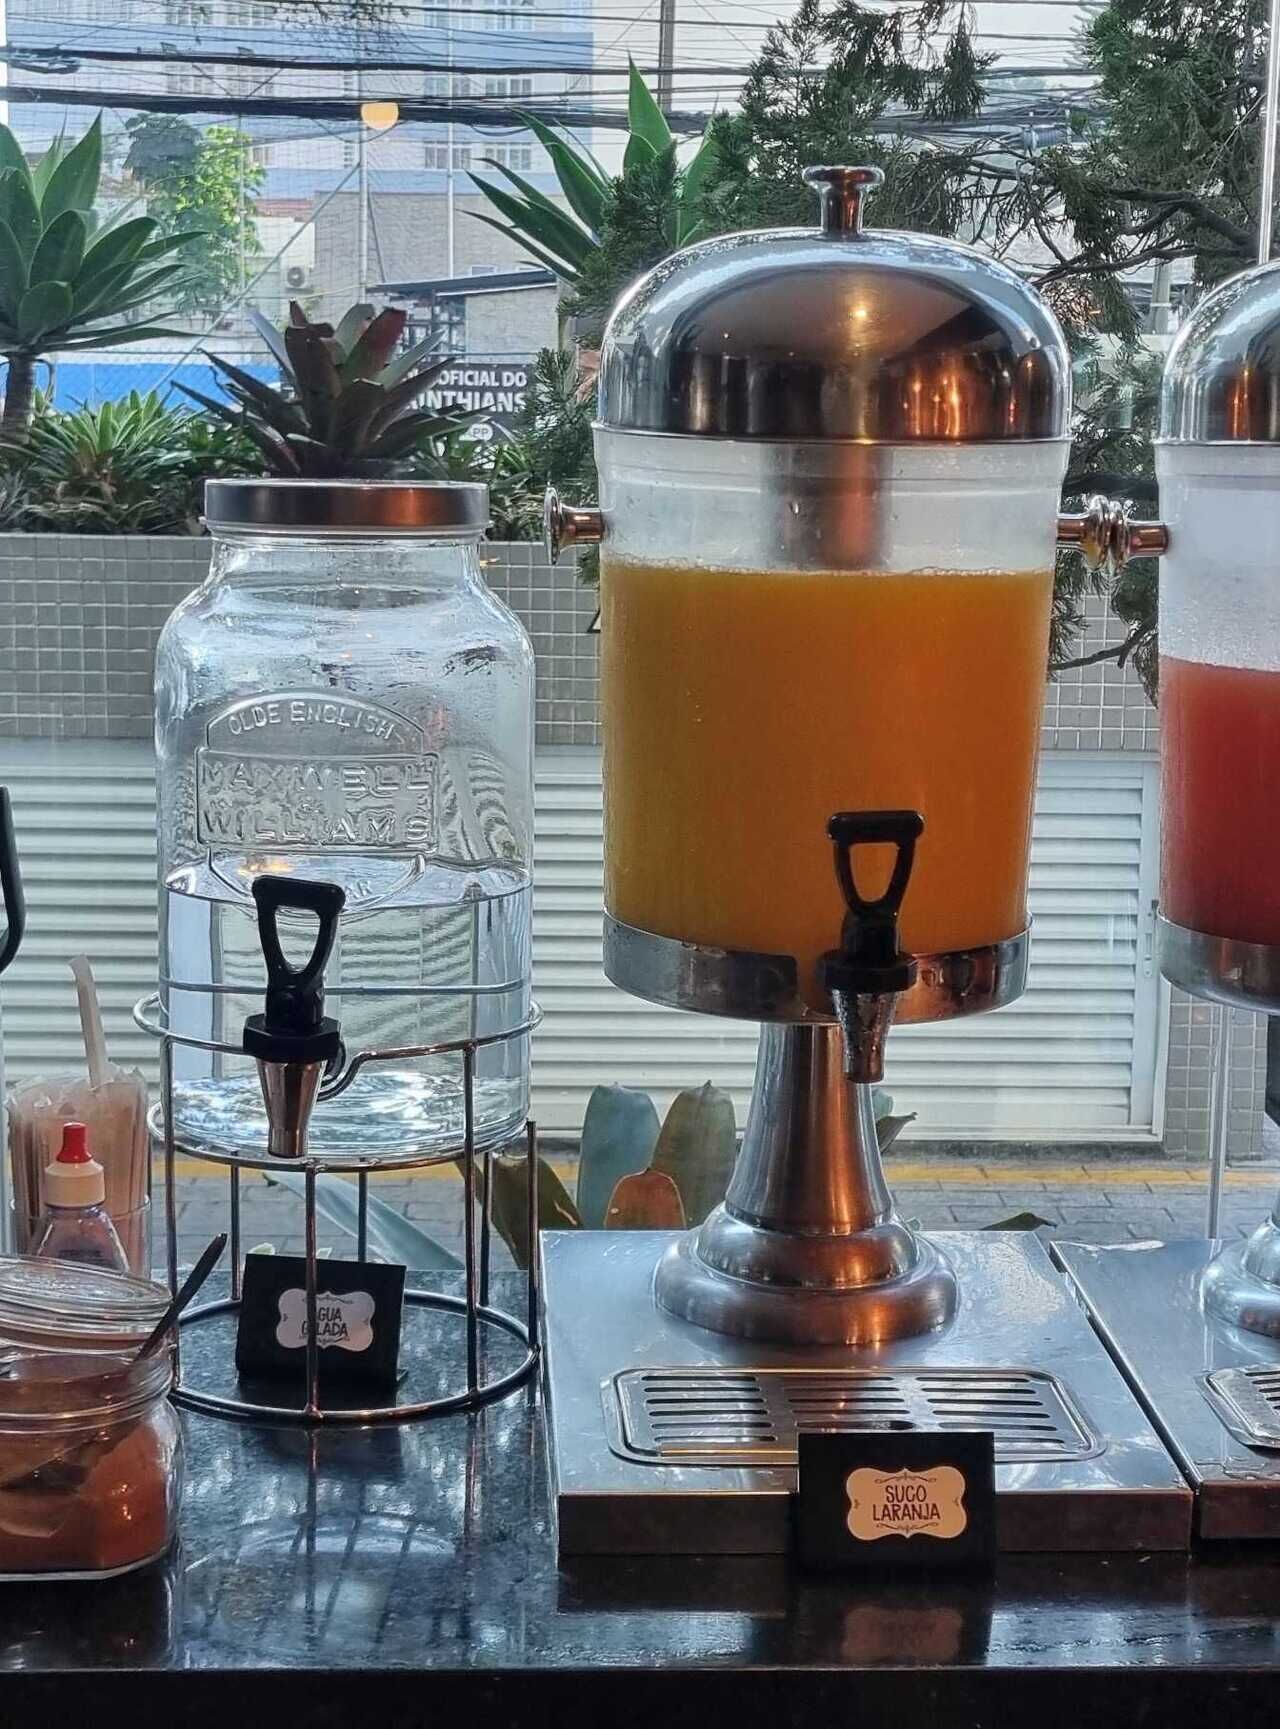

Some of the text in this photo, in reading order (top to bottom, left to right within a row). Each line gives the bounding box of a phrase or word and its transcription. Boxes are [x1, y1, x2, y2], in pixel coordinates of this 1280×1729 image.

[438, 370, 499, 387] OFICIAL
[502, 371, 528, 388] DO
[409, 390, 528, 413] INTHIANS
[227, 701, 395, 740] OLDE ENGLISH
[200, 760, 429, 791] MAXWELL
[201, 808, 429, 842] WILLIAMS
[318, 1306, 342, 1321] GUA
[301, 1320, 348, 1337] GLADA
[884, 1484, 928, 1504] SUCO
[872, 1503, 941, 1521] LARANJA
